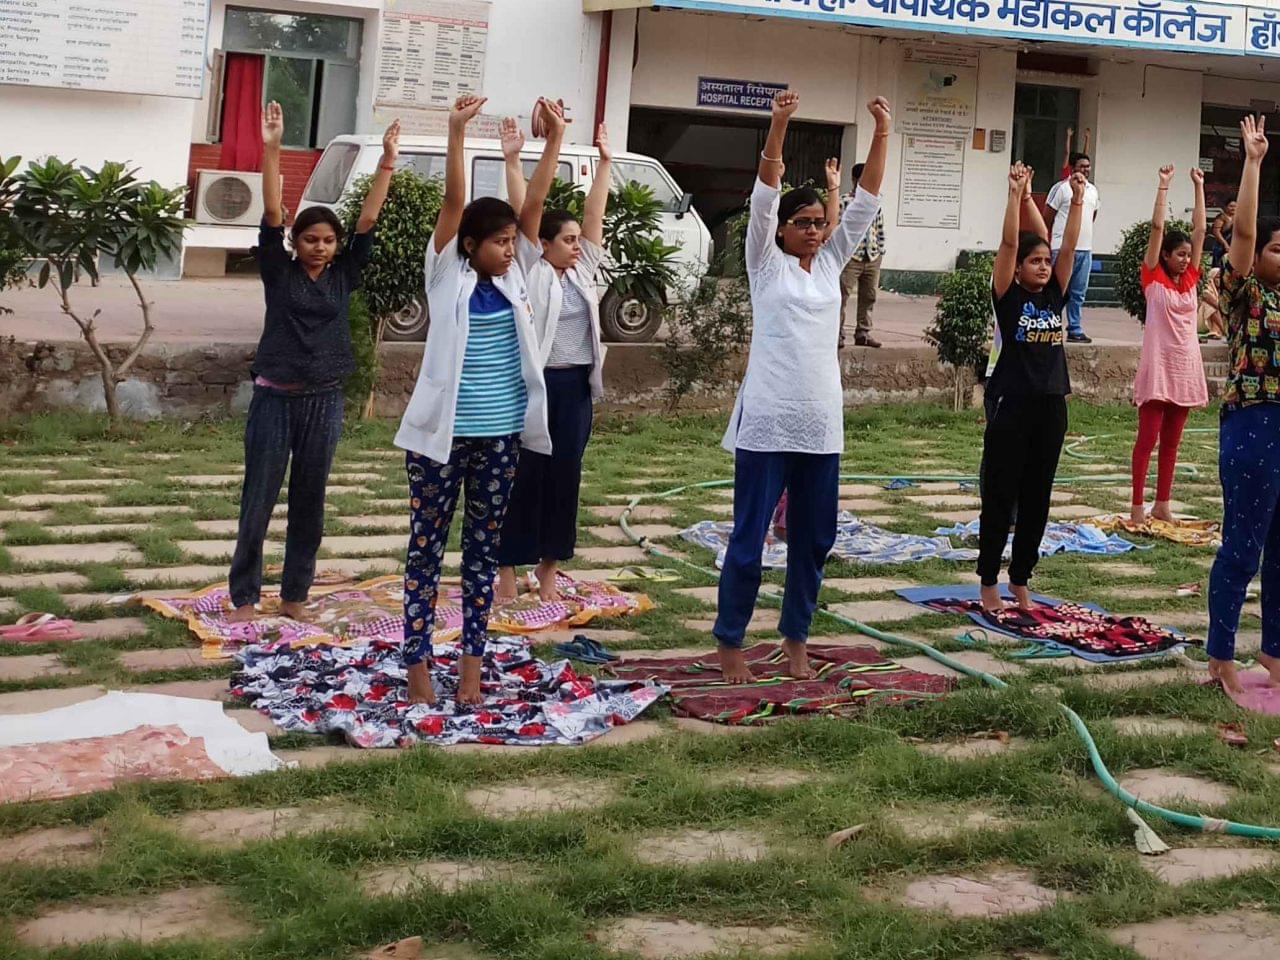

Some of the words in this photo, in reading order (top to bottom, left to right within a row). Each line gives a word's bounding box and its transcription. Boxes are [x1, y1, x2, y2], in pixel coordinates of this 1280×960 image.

[1123, 0, 1232, 43] कॉलेज
[701, 93, 739, 105] HOSPITAL
[740, 95, 773, 107] RECEPT
